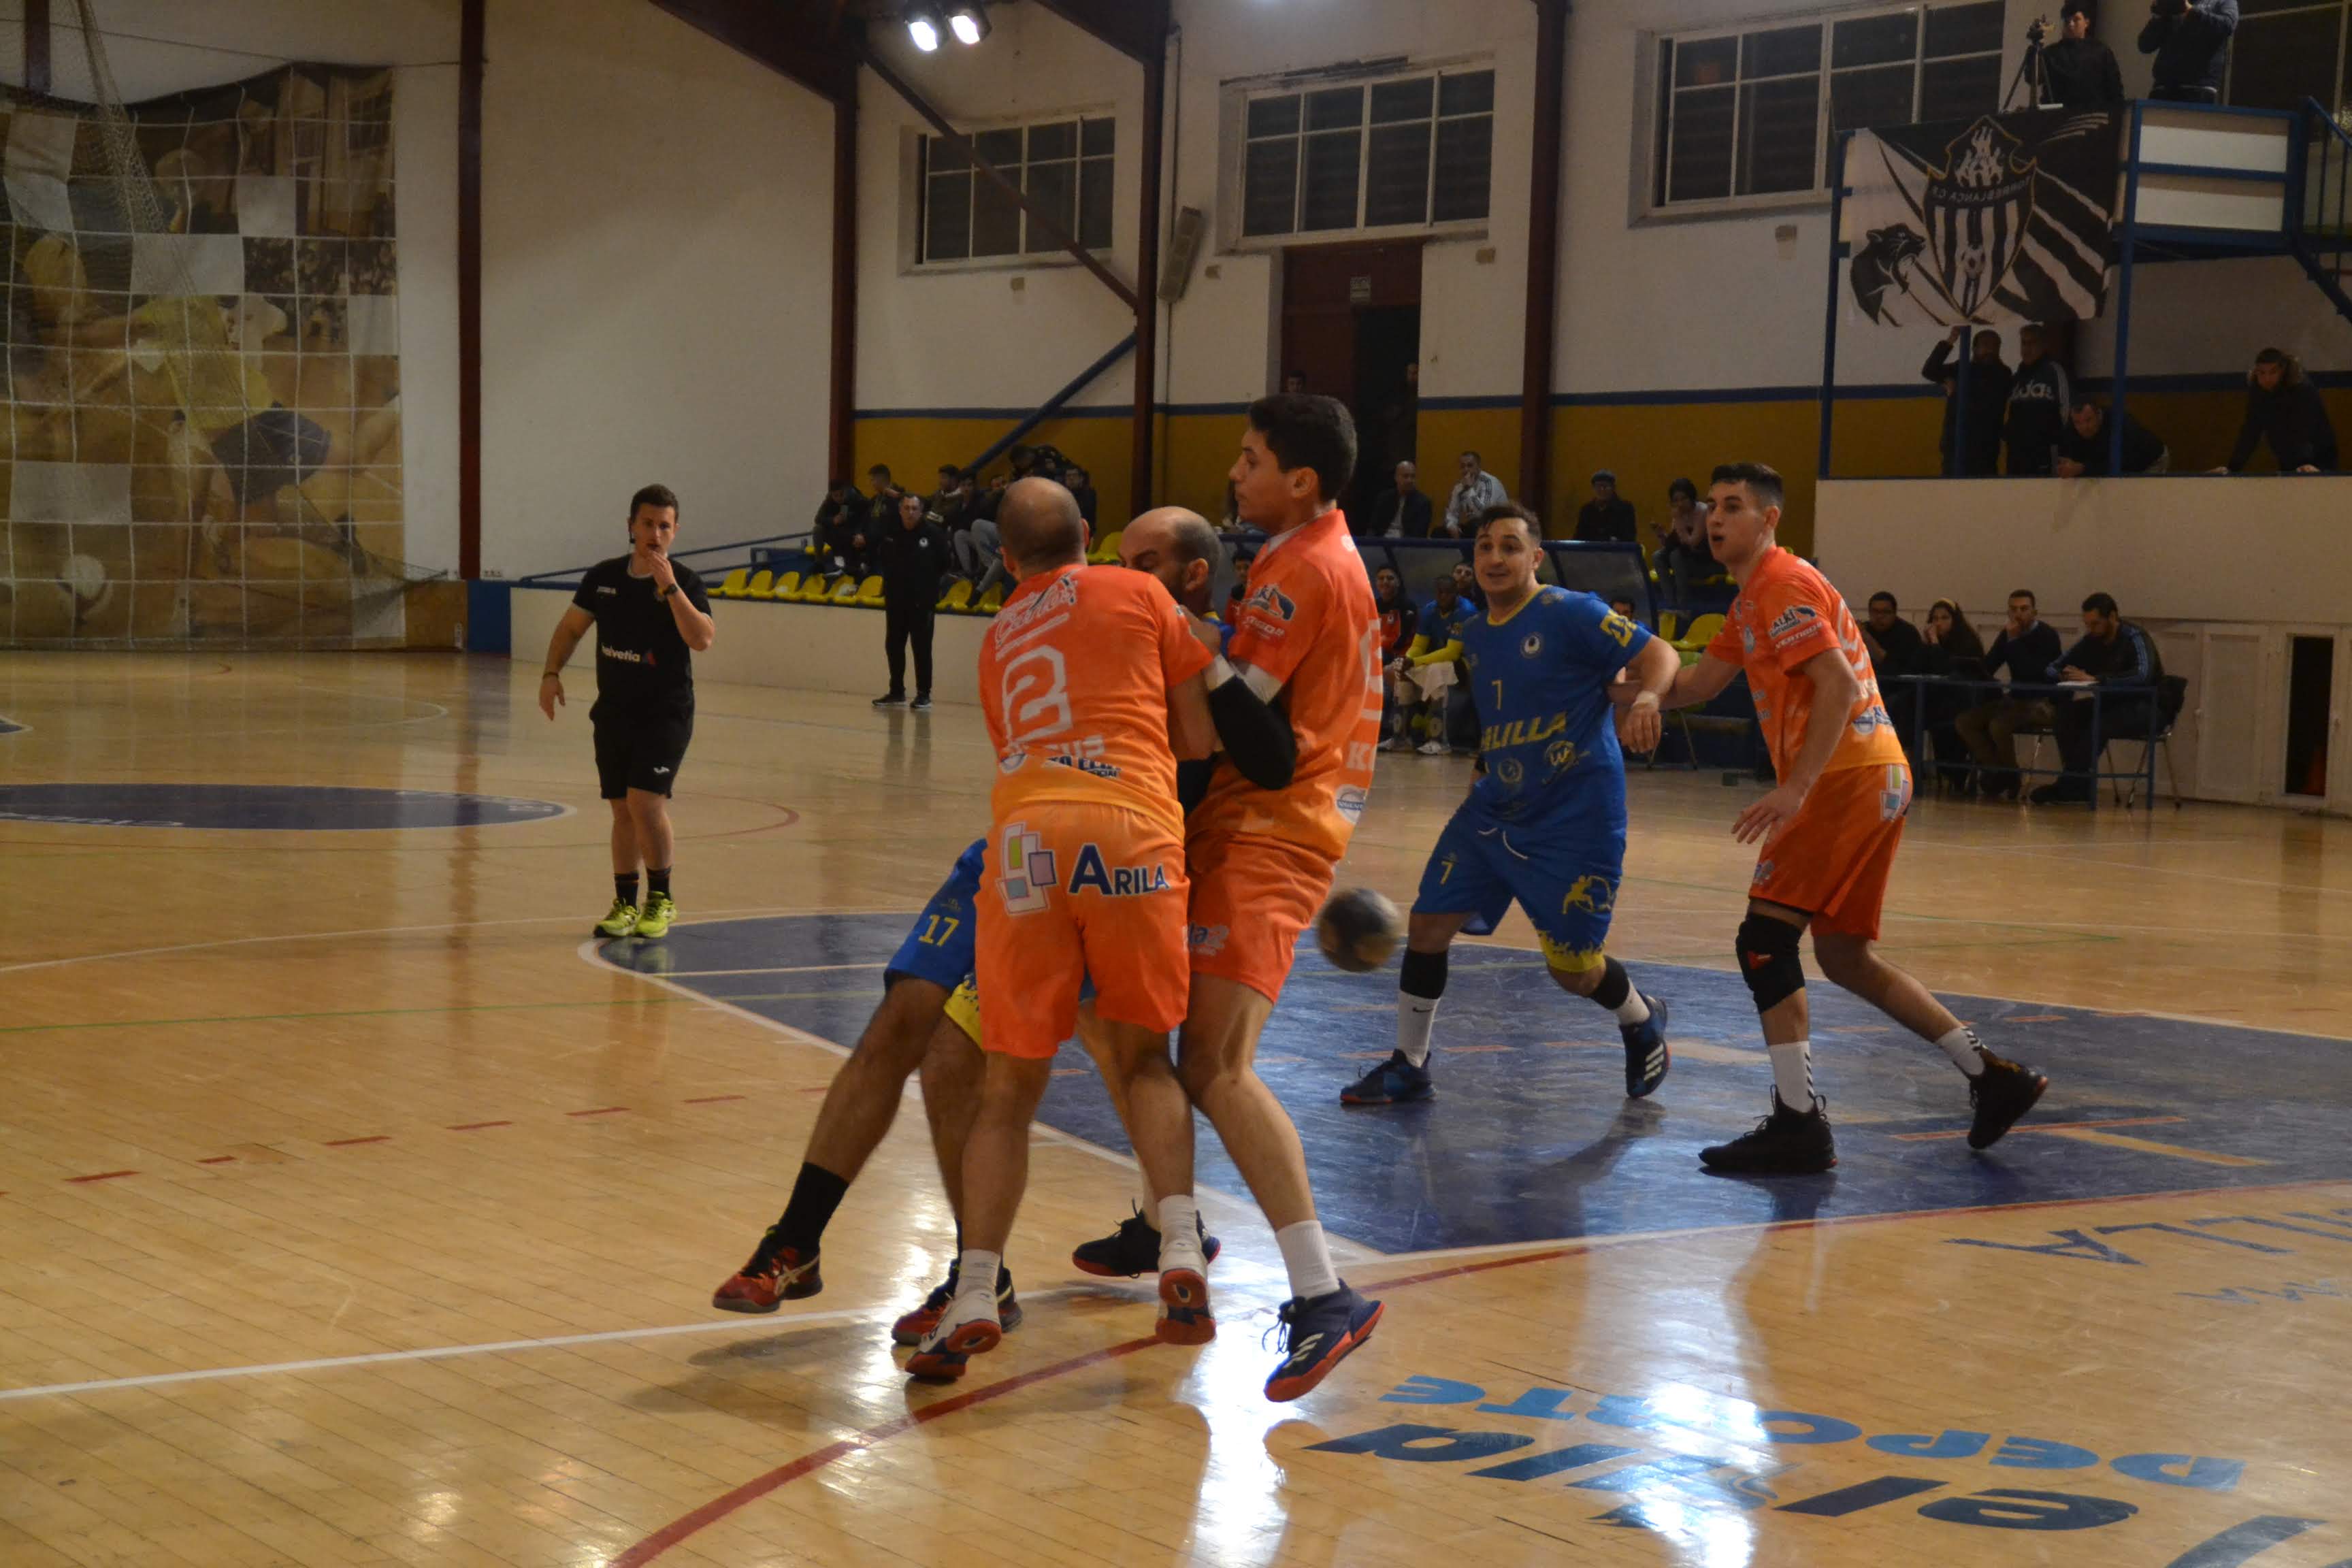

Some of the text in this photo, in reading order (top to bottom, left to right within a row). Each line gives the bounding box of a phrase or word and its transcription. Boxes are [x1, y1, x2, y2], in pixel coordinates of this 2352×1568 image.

[1002, 644, 1073, 745] 2
[1439, 860, 1456, 886] 7
[918, 914, 960, 948] 17
